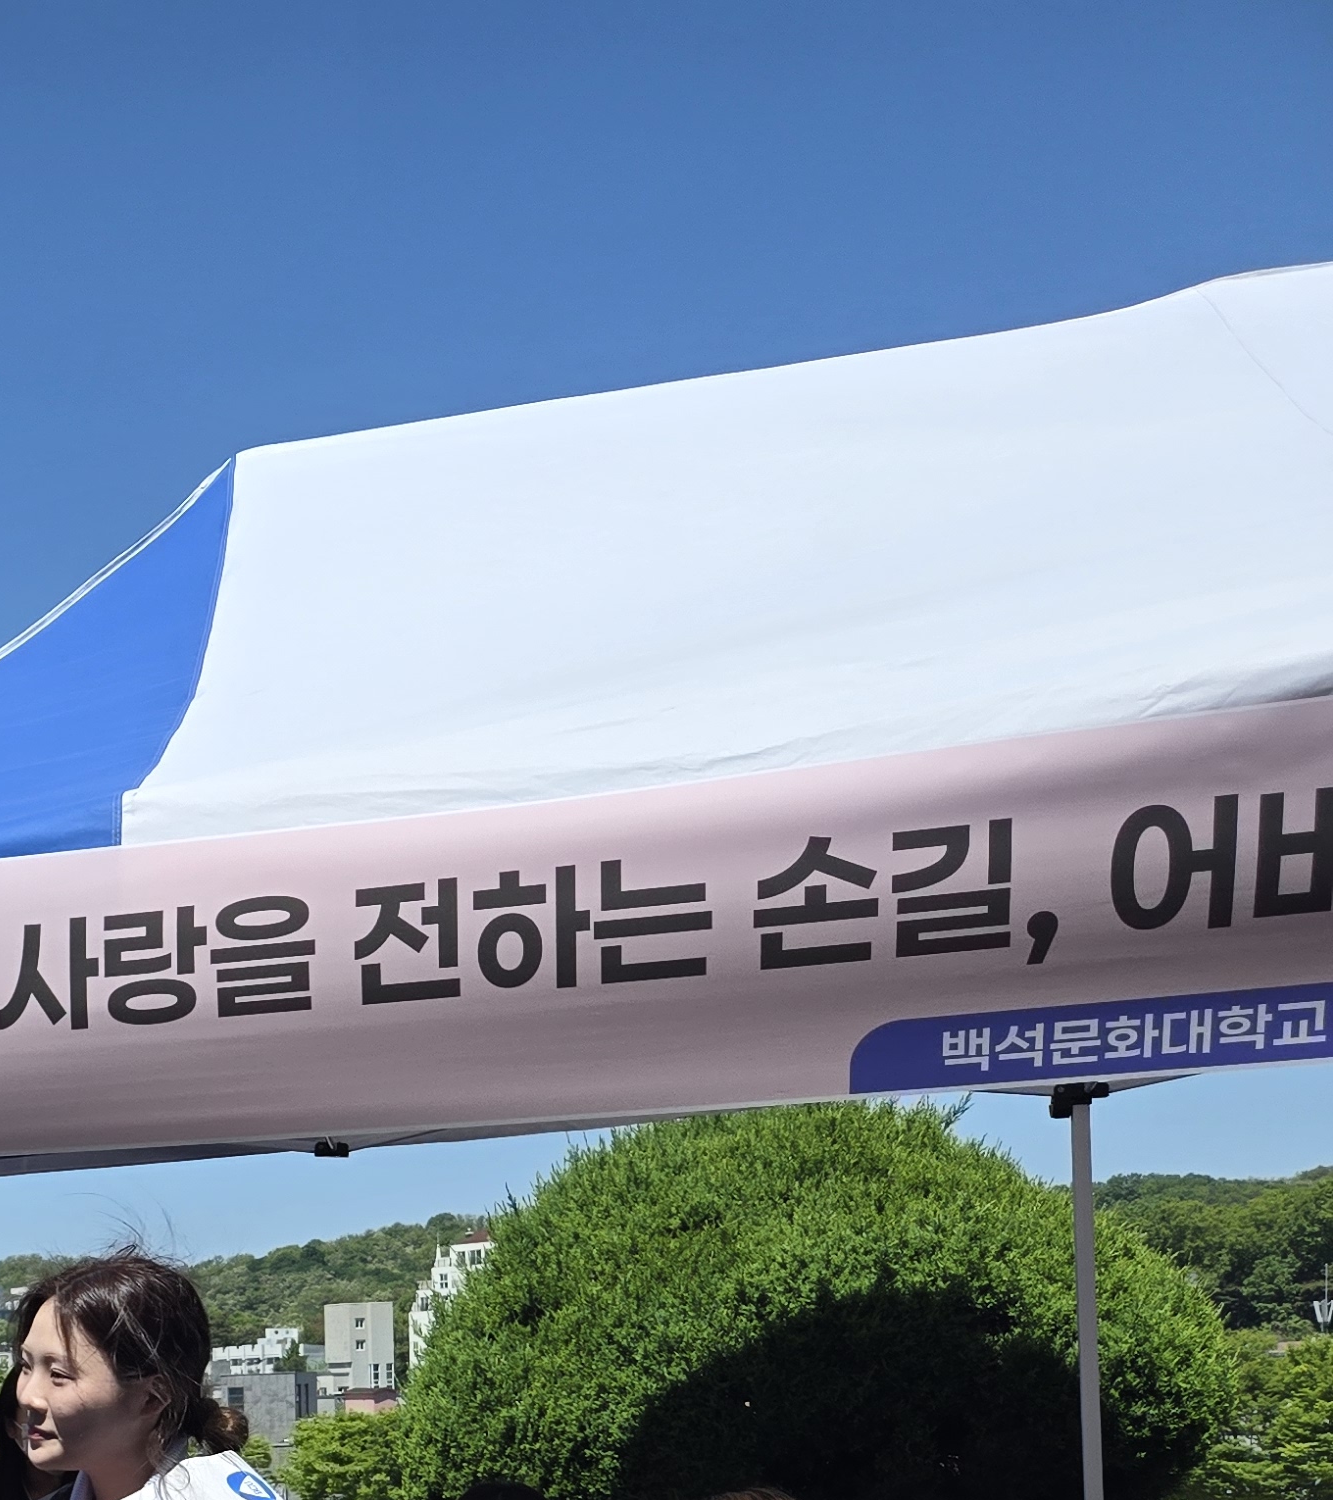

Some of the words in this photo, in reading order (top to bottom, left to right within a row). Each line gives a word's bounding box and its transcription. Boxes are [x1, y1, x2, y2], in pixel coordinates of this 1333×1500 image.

[352, 858, 713, 1007] 전하는
[752, 818, 1058, 966] 손길,
[939, 1000, 1327, 1073] 백석문화대학교
